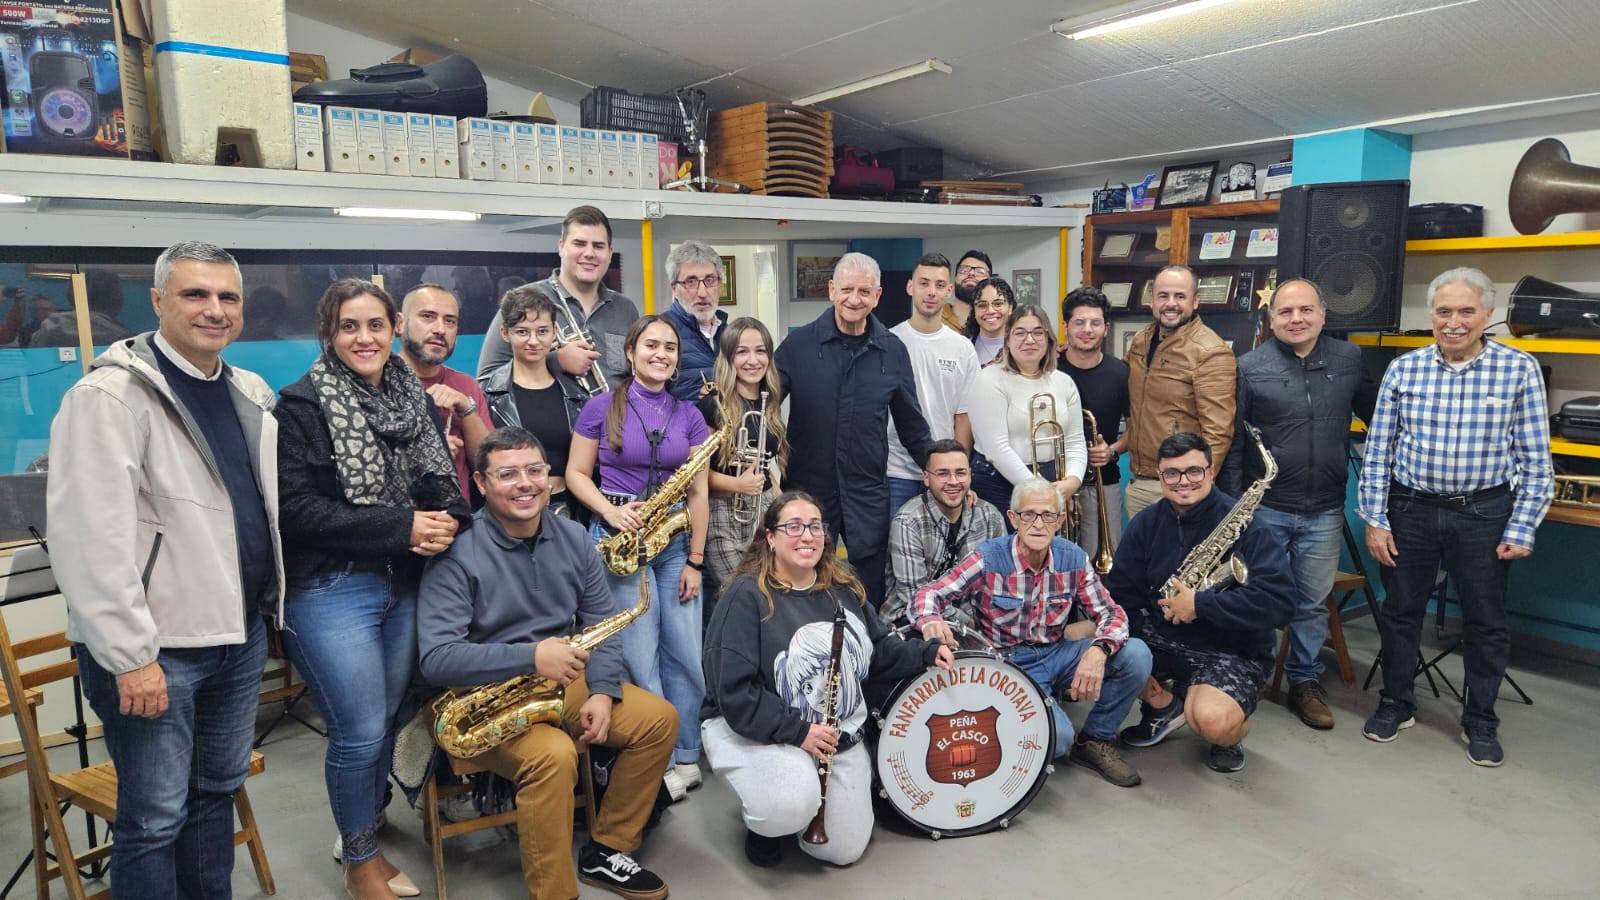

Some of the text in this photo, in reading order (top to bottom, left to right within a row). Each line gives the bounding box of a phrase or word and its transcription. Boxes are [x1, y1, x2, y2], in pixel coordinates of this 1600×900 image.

[889, 666, 1037, 738] FANFARRIA DE LA OROTAVA
[950, 716, 977, 728] PEÑA
[936, 730, 989, 751] EL CASCO
[951, 769, 976, 780] 1963
